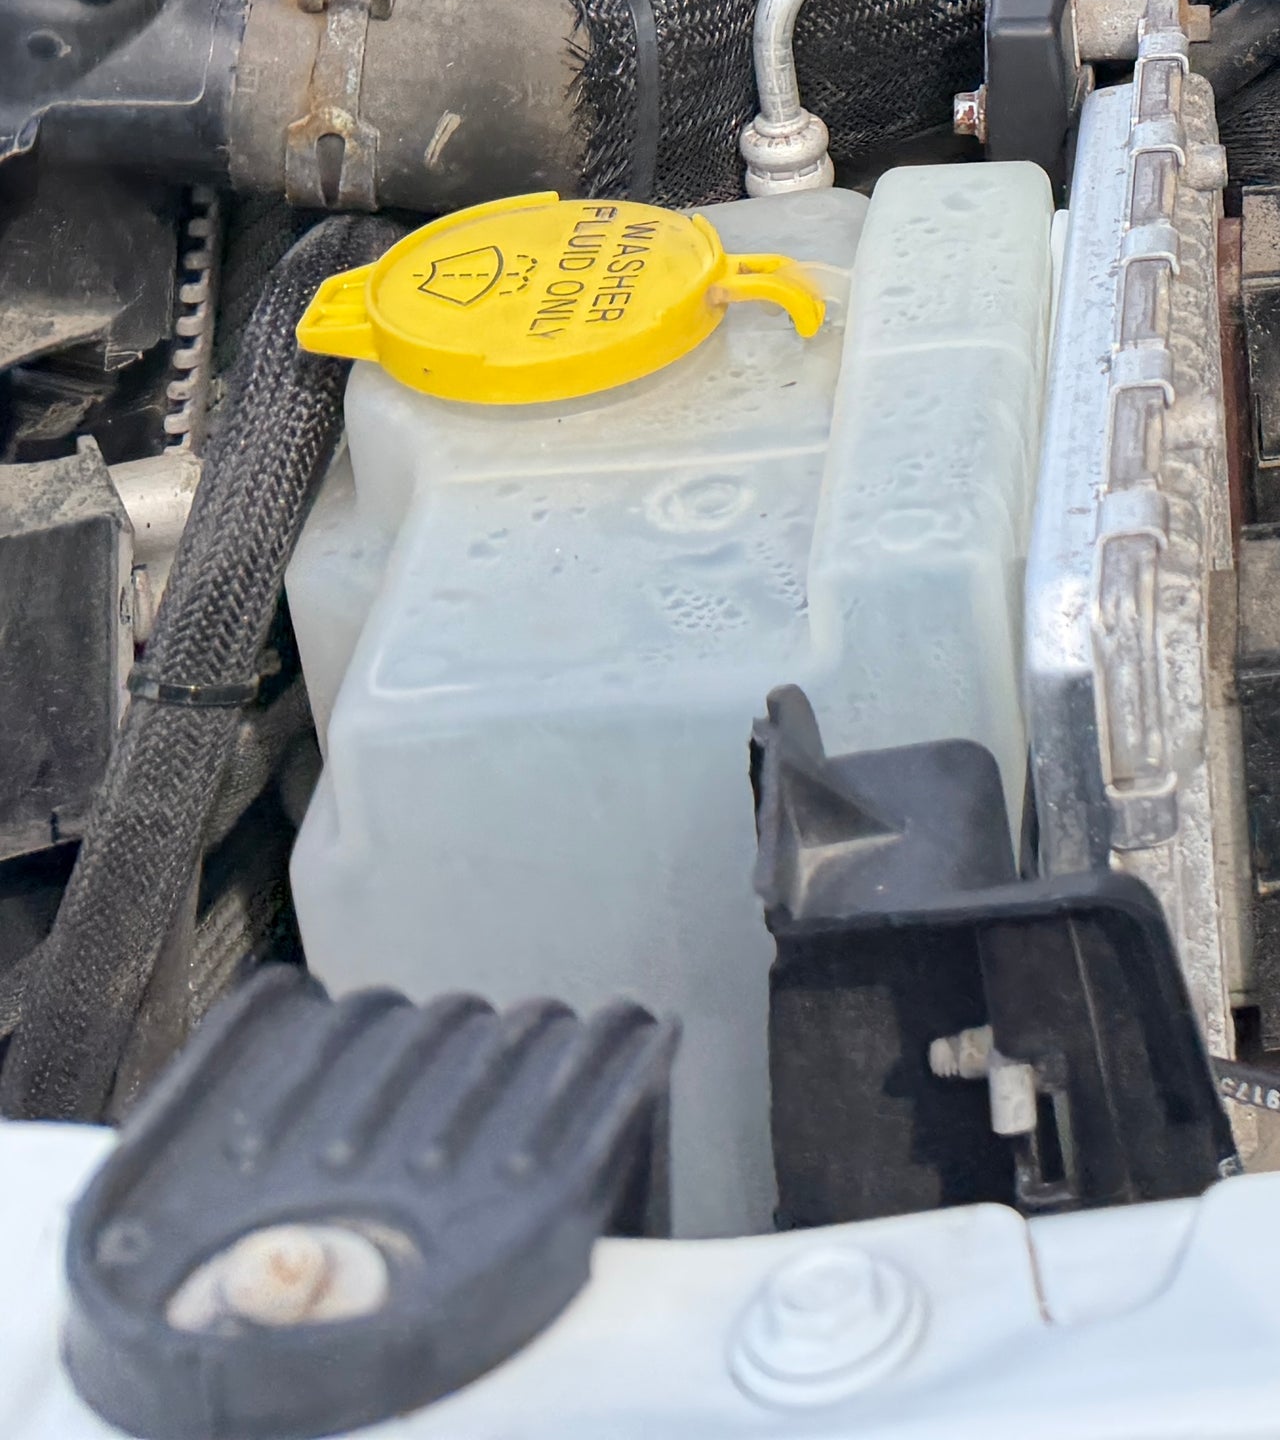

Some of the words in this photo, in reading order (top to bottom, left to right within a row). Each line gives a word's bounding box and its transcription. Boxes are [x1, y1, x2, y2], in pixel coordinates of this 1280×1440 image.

[558, 206, 618, 271] FLUID
[585, 220, 660, 323] WASHER
[526, 280, 585, 340] ONLY
